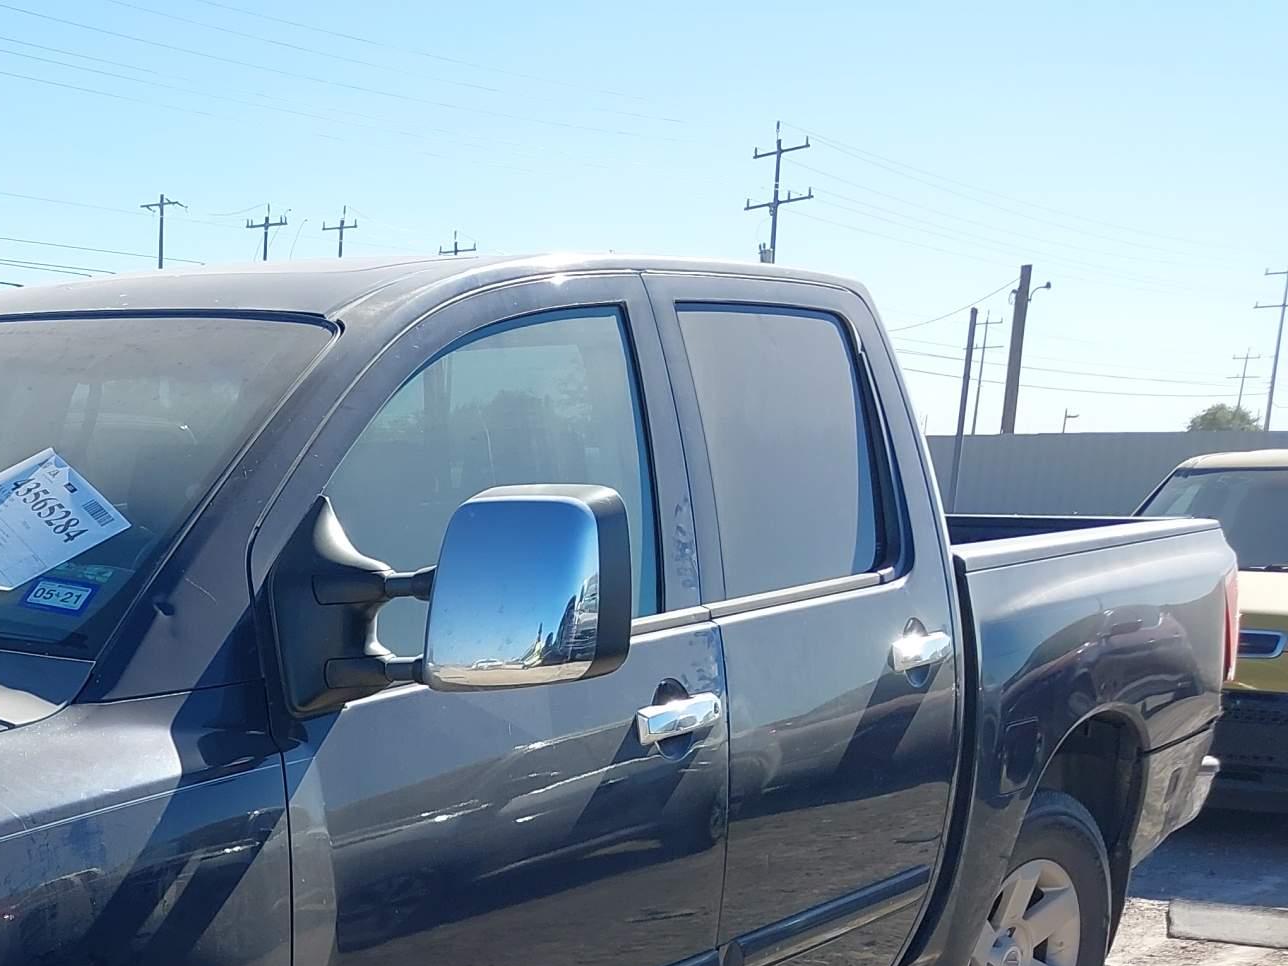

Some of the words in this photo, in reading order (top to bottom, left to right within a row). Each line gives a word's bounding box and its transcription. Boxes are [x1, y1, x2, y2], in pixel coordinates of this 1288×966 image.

[11, 478, 89, 544] 43565284
[33, 587, 56, 600] 05
[60, 591, 82, 605] 21
